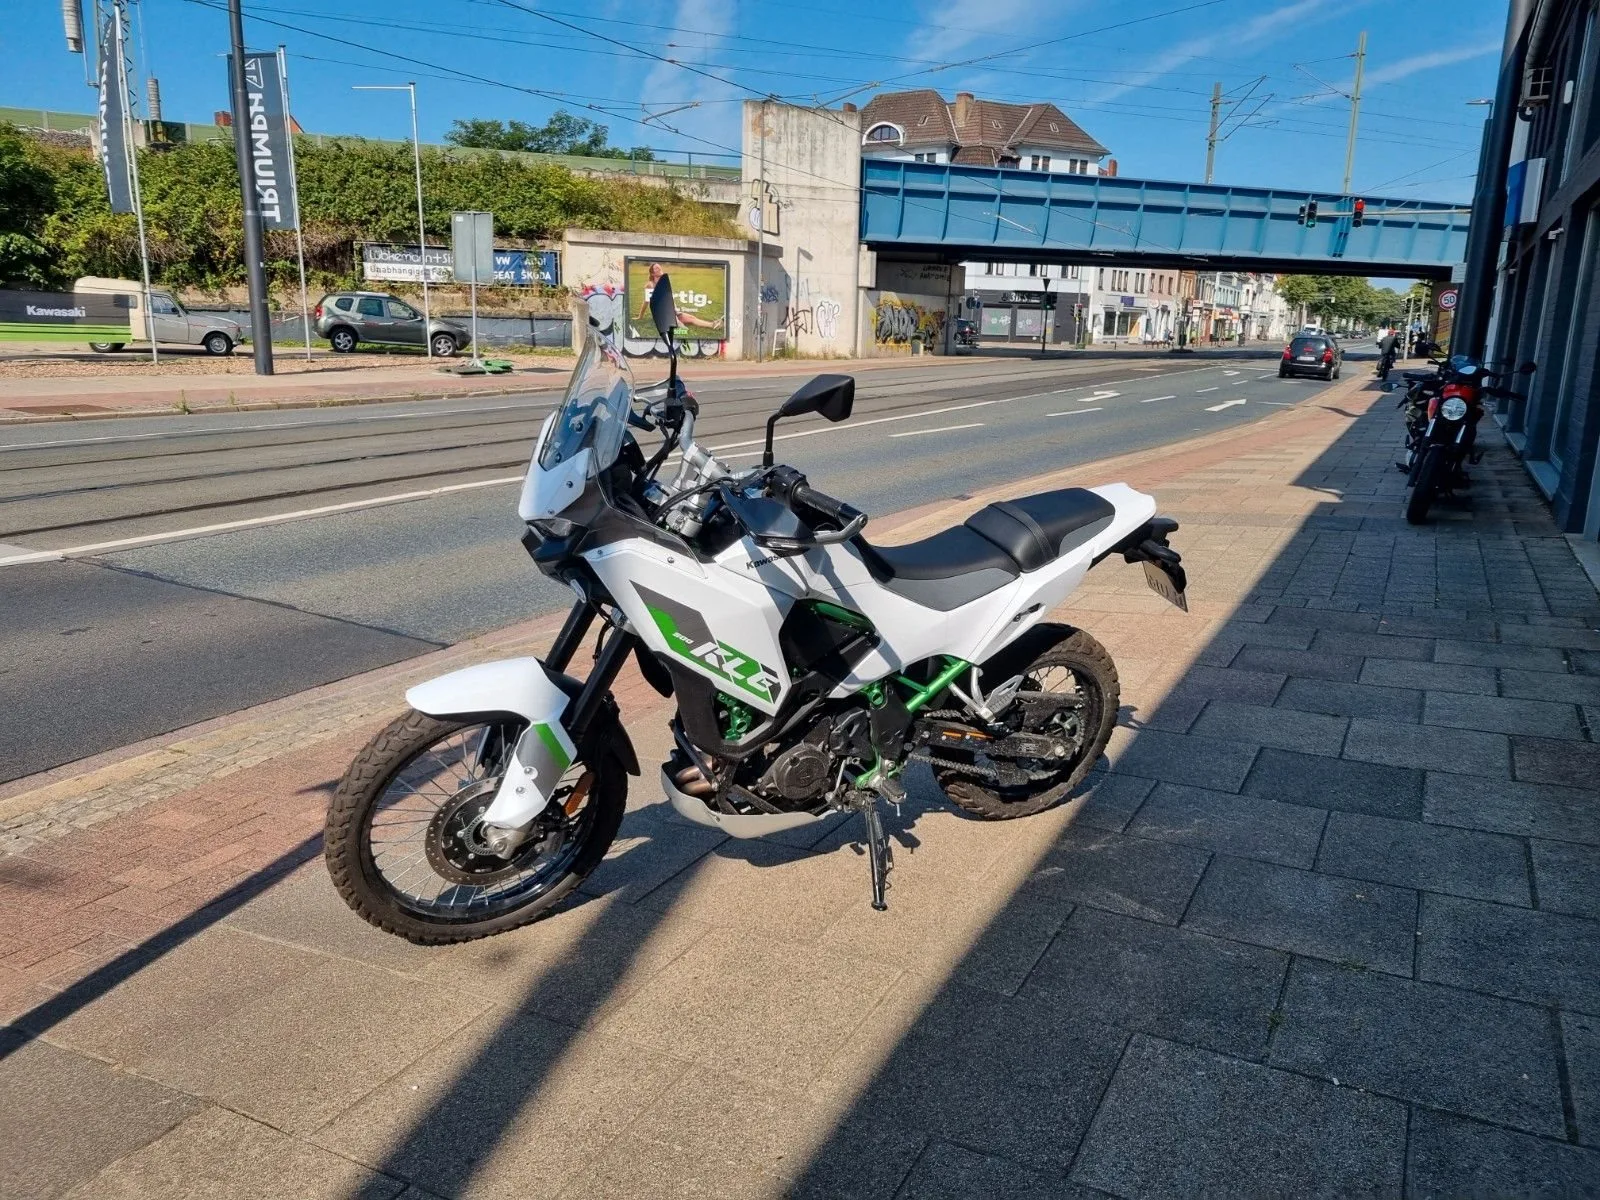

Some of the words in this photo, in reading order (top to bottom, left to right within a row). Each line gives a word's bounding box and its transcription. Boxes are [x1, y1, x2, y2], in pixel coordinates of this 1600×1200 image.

[495, 256, 511, 265] VW
[645, 288, 713, 307] Frtig.
[1443, 295, 1456, 304] 50
[26, 304, 87, 317] Kawasaki
[745, 555, 780, 570] Kawas
